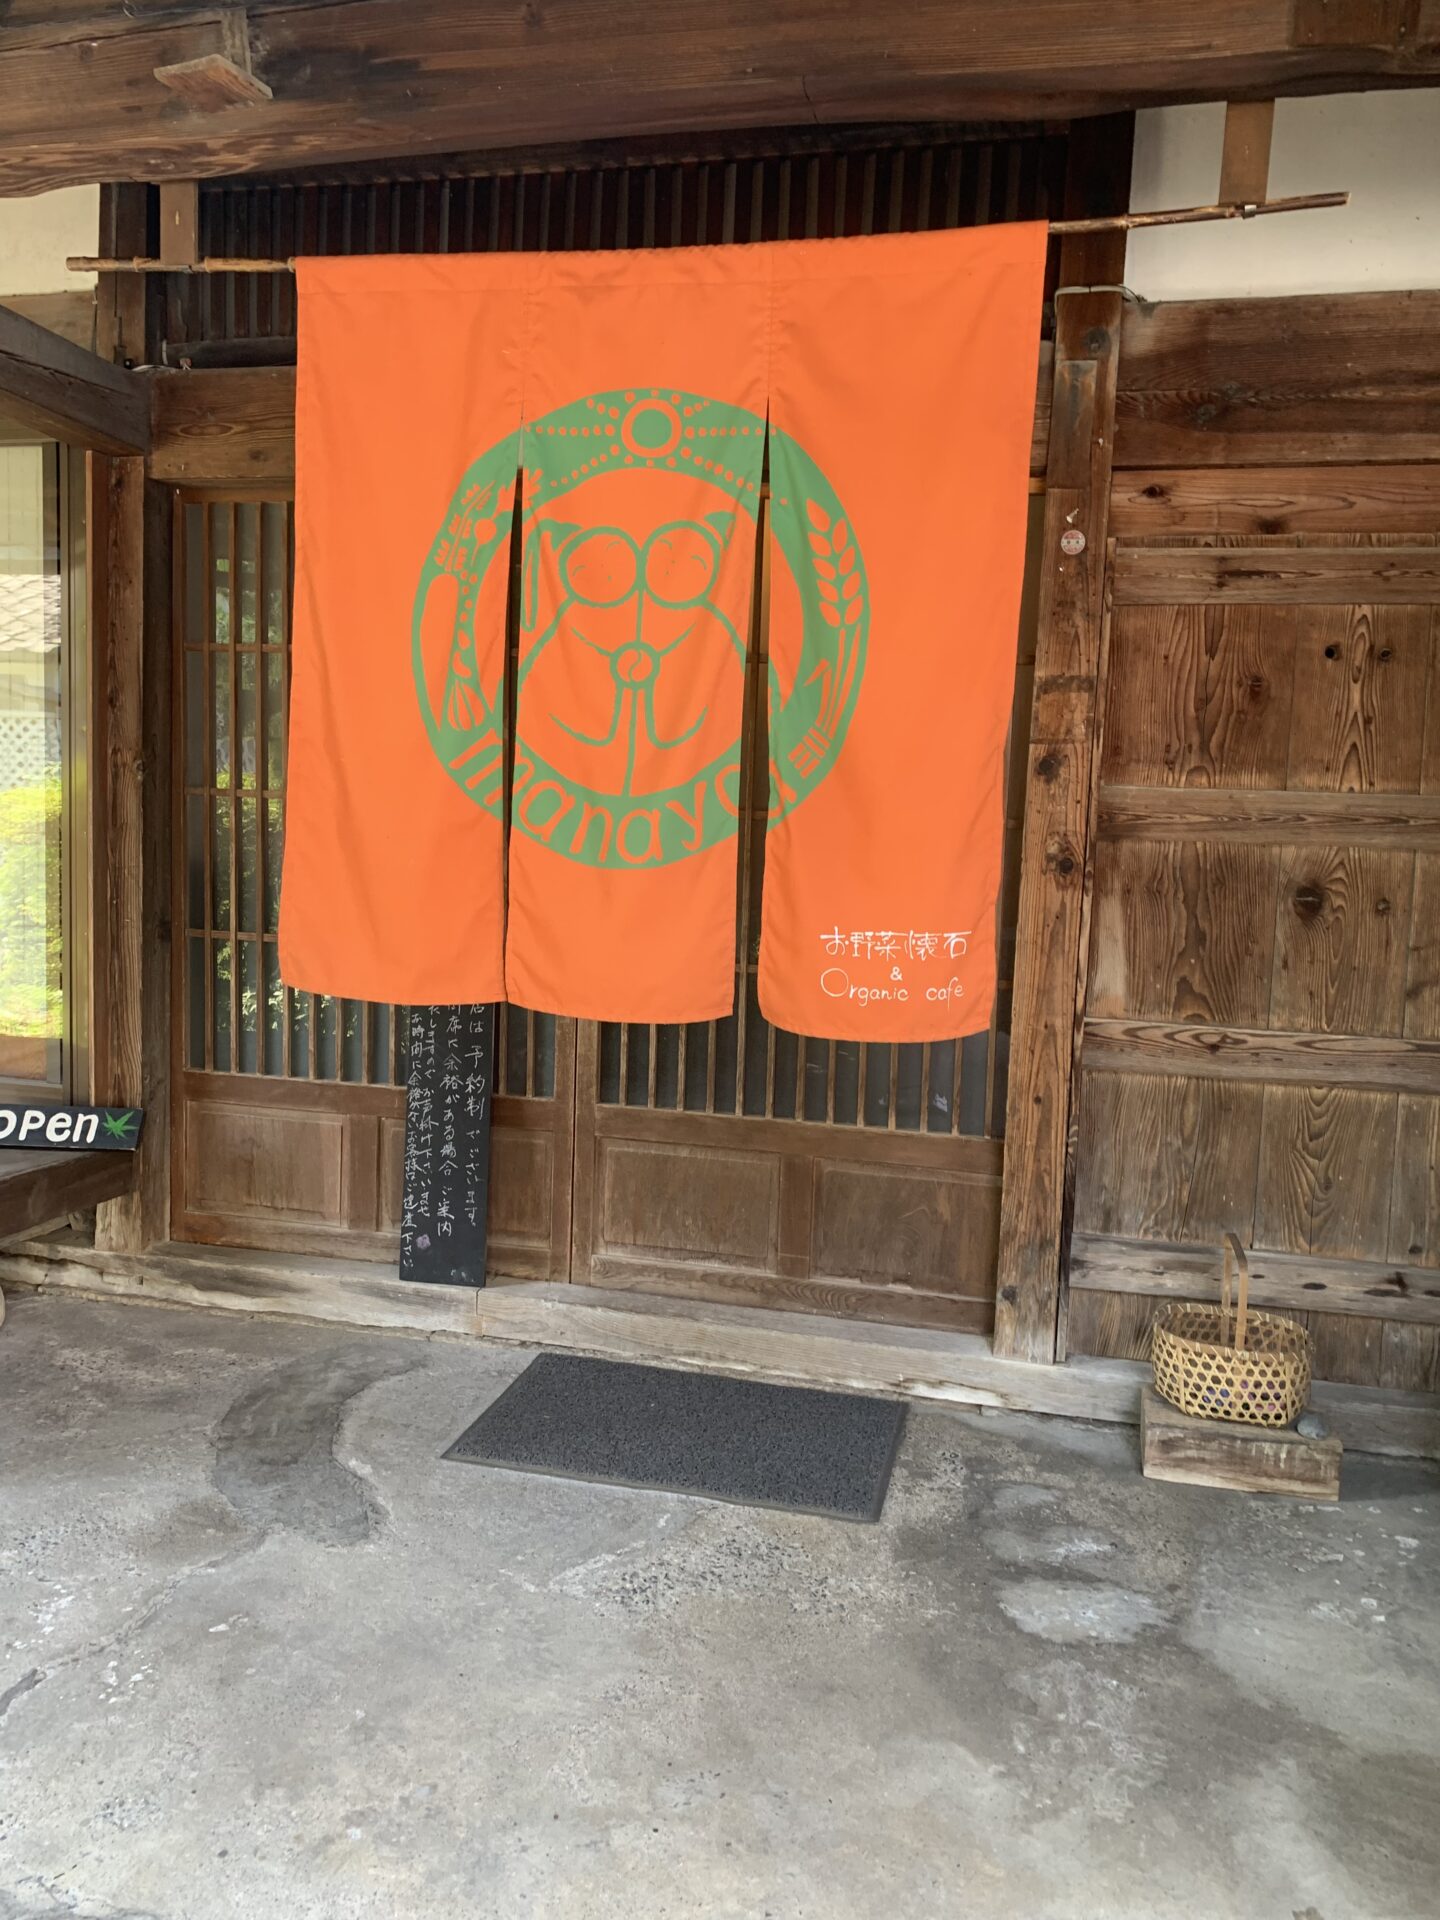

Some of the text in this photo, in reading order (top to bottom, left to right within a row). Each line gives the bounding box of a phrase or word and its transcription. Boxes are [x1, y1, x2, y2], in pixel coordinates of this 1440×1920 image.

[820, 926, 972, 961] お野菜懐石
[820, 967, 965, 1010] Organic cafe
[890, 966, 903, 981] &
